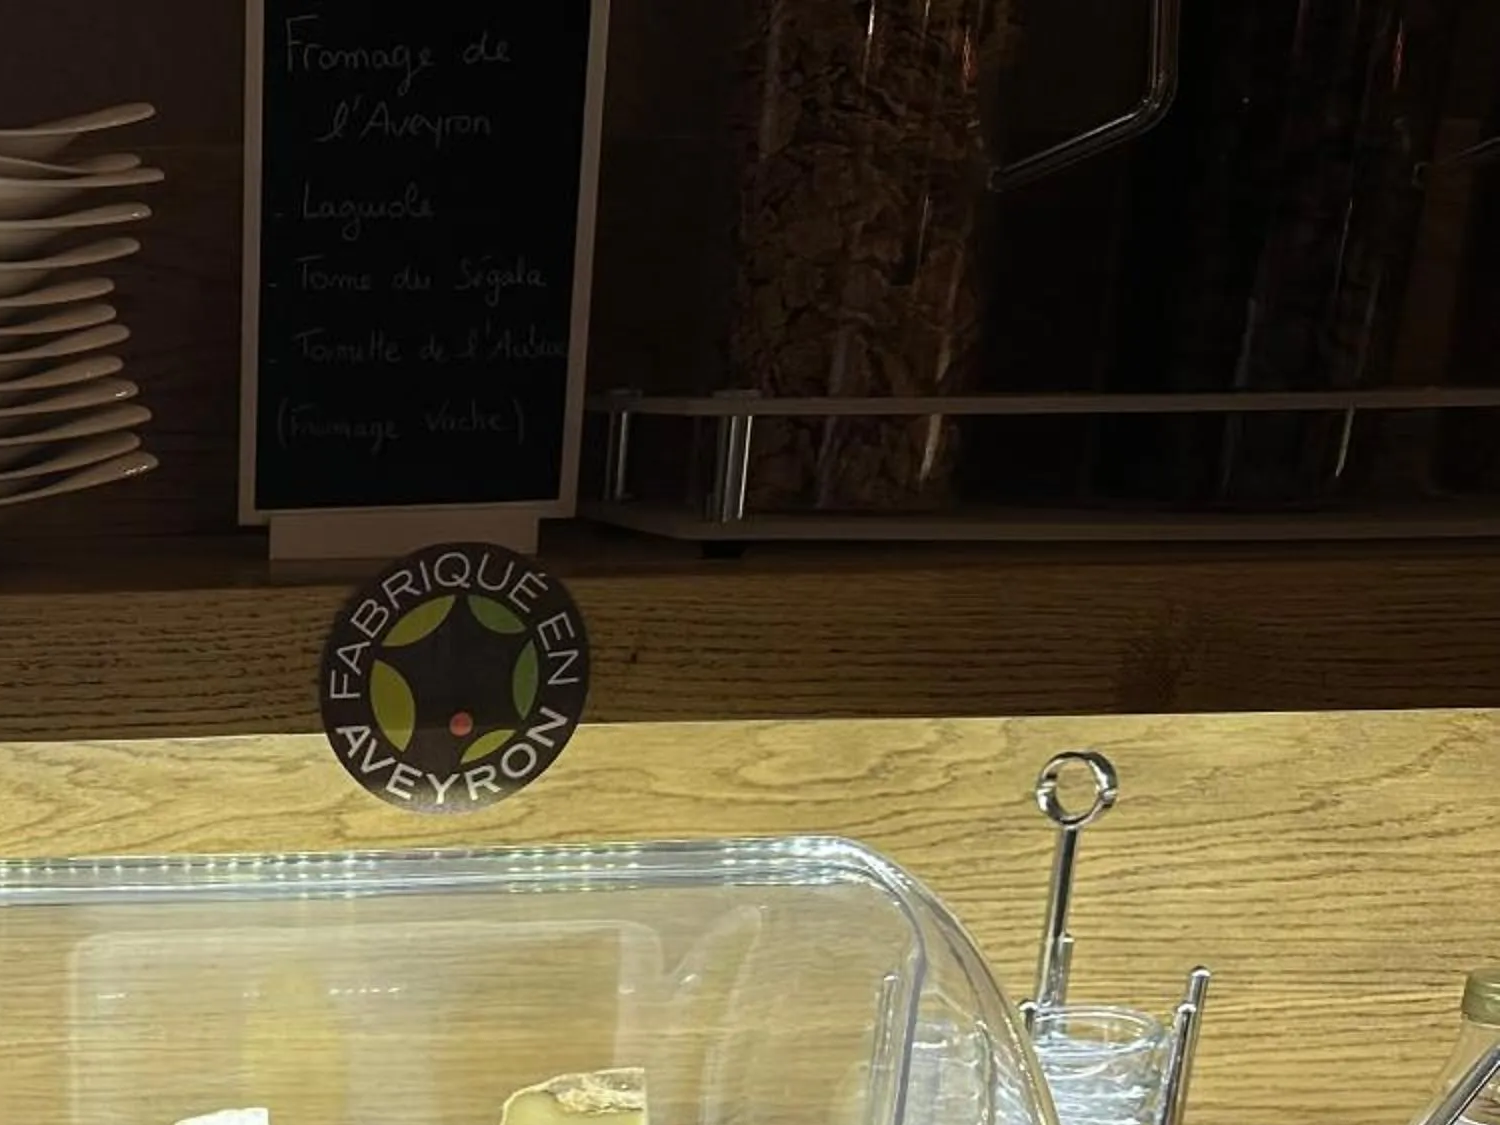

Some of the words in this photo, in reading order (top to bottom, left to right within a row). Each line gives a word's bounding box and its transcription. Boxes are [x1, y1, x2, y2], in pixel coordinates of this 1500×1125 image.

[286, 14, 435, 96] Fromage
[462, 29, 512, 64] de
[313, 95, 493, 149] l'Aveyron
[392, 263, 432, 291] du
[418, 332, 450, 363] de
[537, 611, 581, 686] EN
[335, 706, 569, 805] AVEYRON
